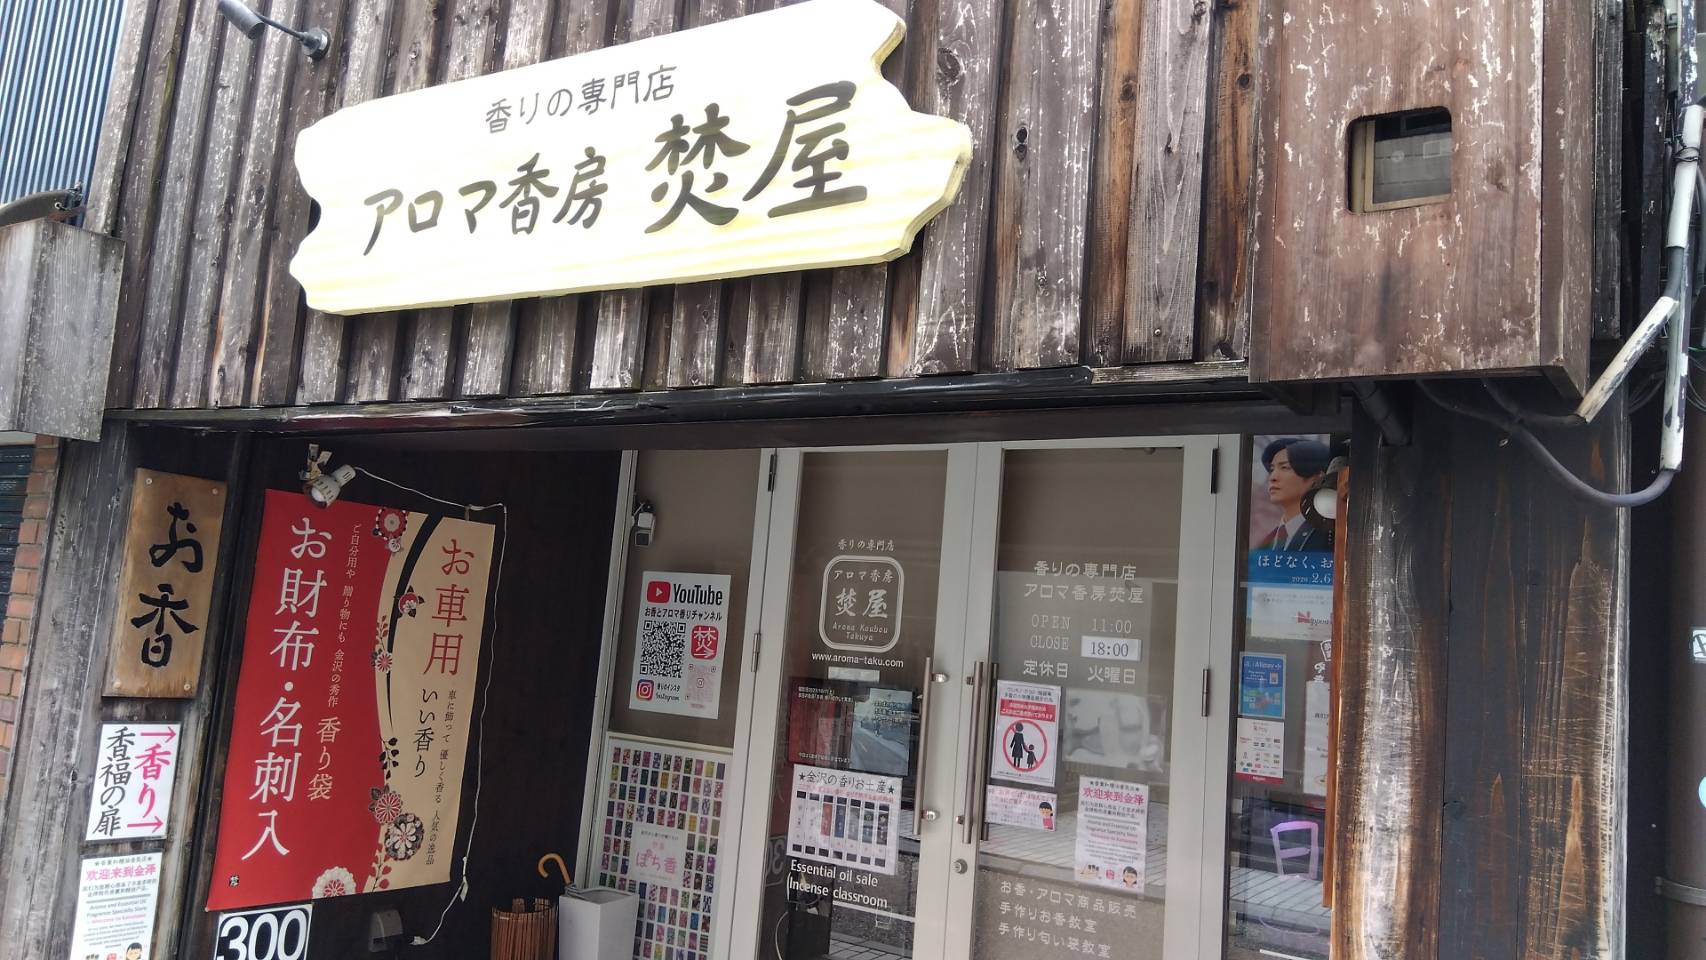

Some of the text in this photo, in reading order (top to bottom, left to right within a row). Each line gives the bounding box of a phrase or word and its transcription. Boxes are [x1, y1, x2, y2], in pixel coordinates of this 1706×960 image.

[485, 65, 677, 134] 香りの専門店
[363, 80, 868, 255] アロマ香房 焚屋
[346, 523, 362, 579] ご自分用や
[838, 539, 895, 551] 香りの専門店
[131, 502, 204, 668] お香
[833, 569, 895, 583] アロマ香房
[1034, 560, 1136, 581] 香りの専門店
[424, 538, 475, 676] お車用
[673, 583, 723, 605] YouTube
[835, 588, 888, 618] 焚屋
[1024, 583, 1145, 605] アロマ香房焚屋
[644, 607, 722, 621] お香とアロマ香りチャンネル
[1031, 614, 1132, 634] OPEN 11:00
[846, 631, 873, 642] Takuya
[1030, 635, 1129, 657] CLOSE 18:00
[811, 652, 904, 668] www.aroma-taku.com
[1023, 660, 1136, 685] 定休日 火曜日
[241, 517, 333, 860] お財布・名刺入
[328, 649, 345, 708] 金沢の秀作
[413, 688, 438, 778] いい香り
[307, 716, 341, 801] 香り袋
[92, 726, 136, 836] 香福の扉
[134, 743, 172, 819] 香り
[807, 770, 887, 794] 金沢の香りお土産
[790, 859, 878, 887] Essential oil sale
[833, 886, 888, 908] classroom
[1000, 880, 1137, 919] お香・アロマ商品販売
[999, 901, 1097, 933] 手作りお香教室
[217, 910, 307, 960] 300
